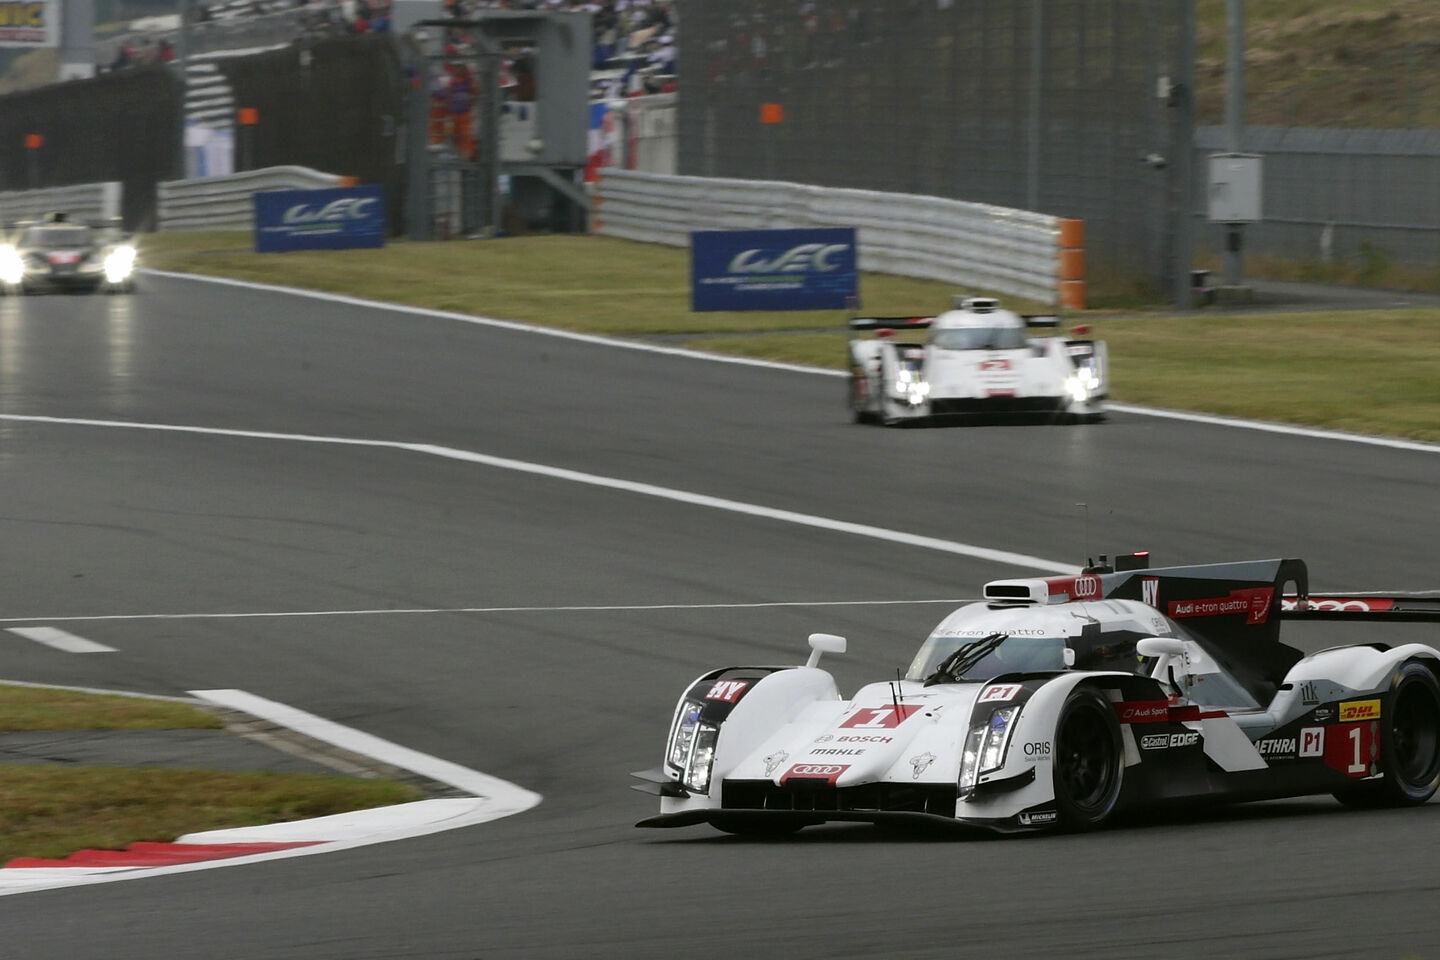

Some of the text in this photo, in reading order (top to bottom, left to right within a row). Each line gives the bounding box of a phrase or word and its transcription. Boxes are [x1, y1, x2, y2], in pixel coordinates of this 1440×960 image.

[283, 198, 378, 224] WEC
[728, 243, 850, 274] WEC
[1142, 580, 1159, 607] HY
[1176, 603, 1194, 614] Audi
[1195, 600, 1218, 612] e-tron
[1219, 598, 1248, 612] quattro
[984, 686, 1013, 699] P1
[853, 708, 894, 728] 1
[1135, 707, 1169, 717] Audi Sport
[1346, 705, 1373, 718] DHL
[836, 736, 893, 744] BOSCH
[1170, 733, 1199, 747] EDGE
[1254, 738, 1296, 754] AETHRA
[1303, 732, 1321, 753] P1
[809, 748, 867, 756] MAHLE
[1023, 741, 1051, 755] ORIS
[1348, 727, 1366, 774] 1
[1031, 812, 1056, 820] MICHELIN
